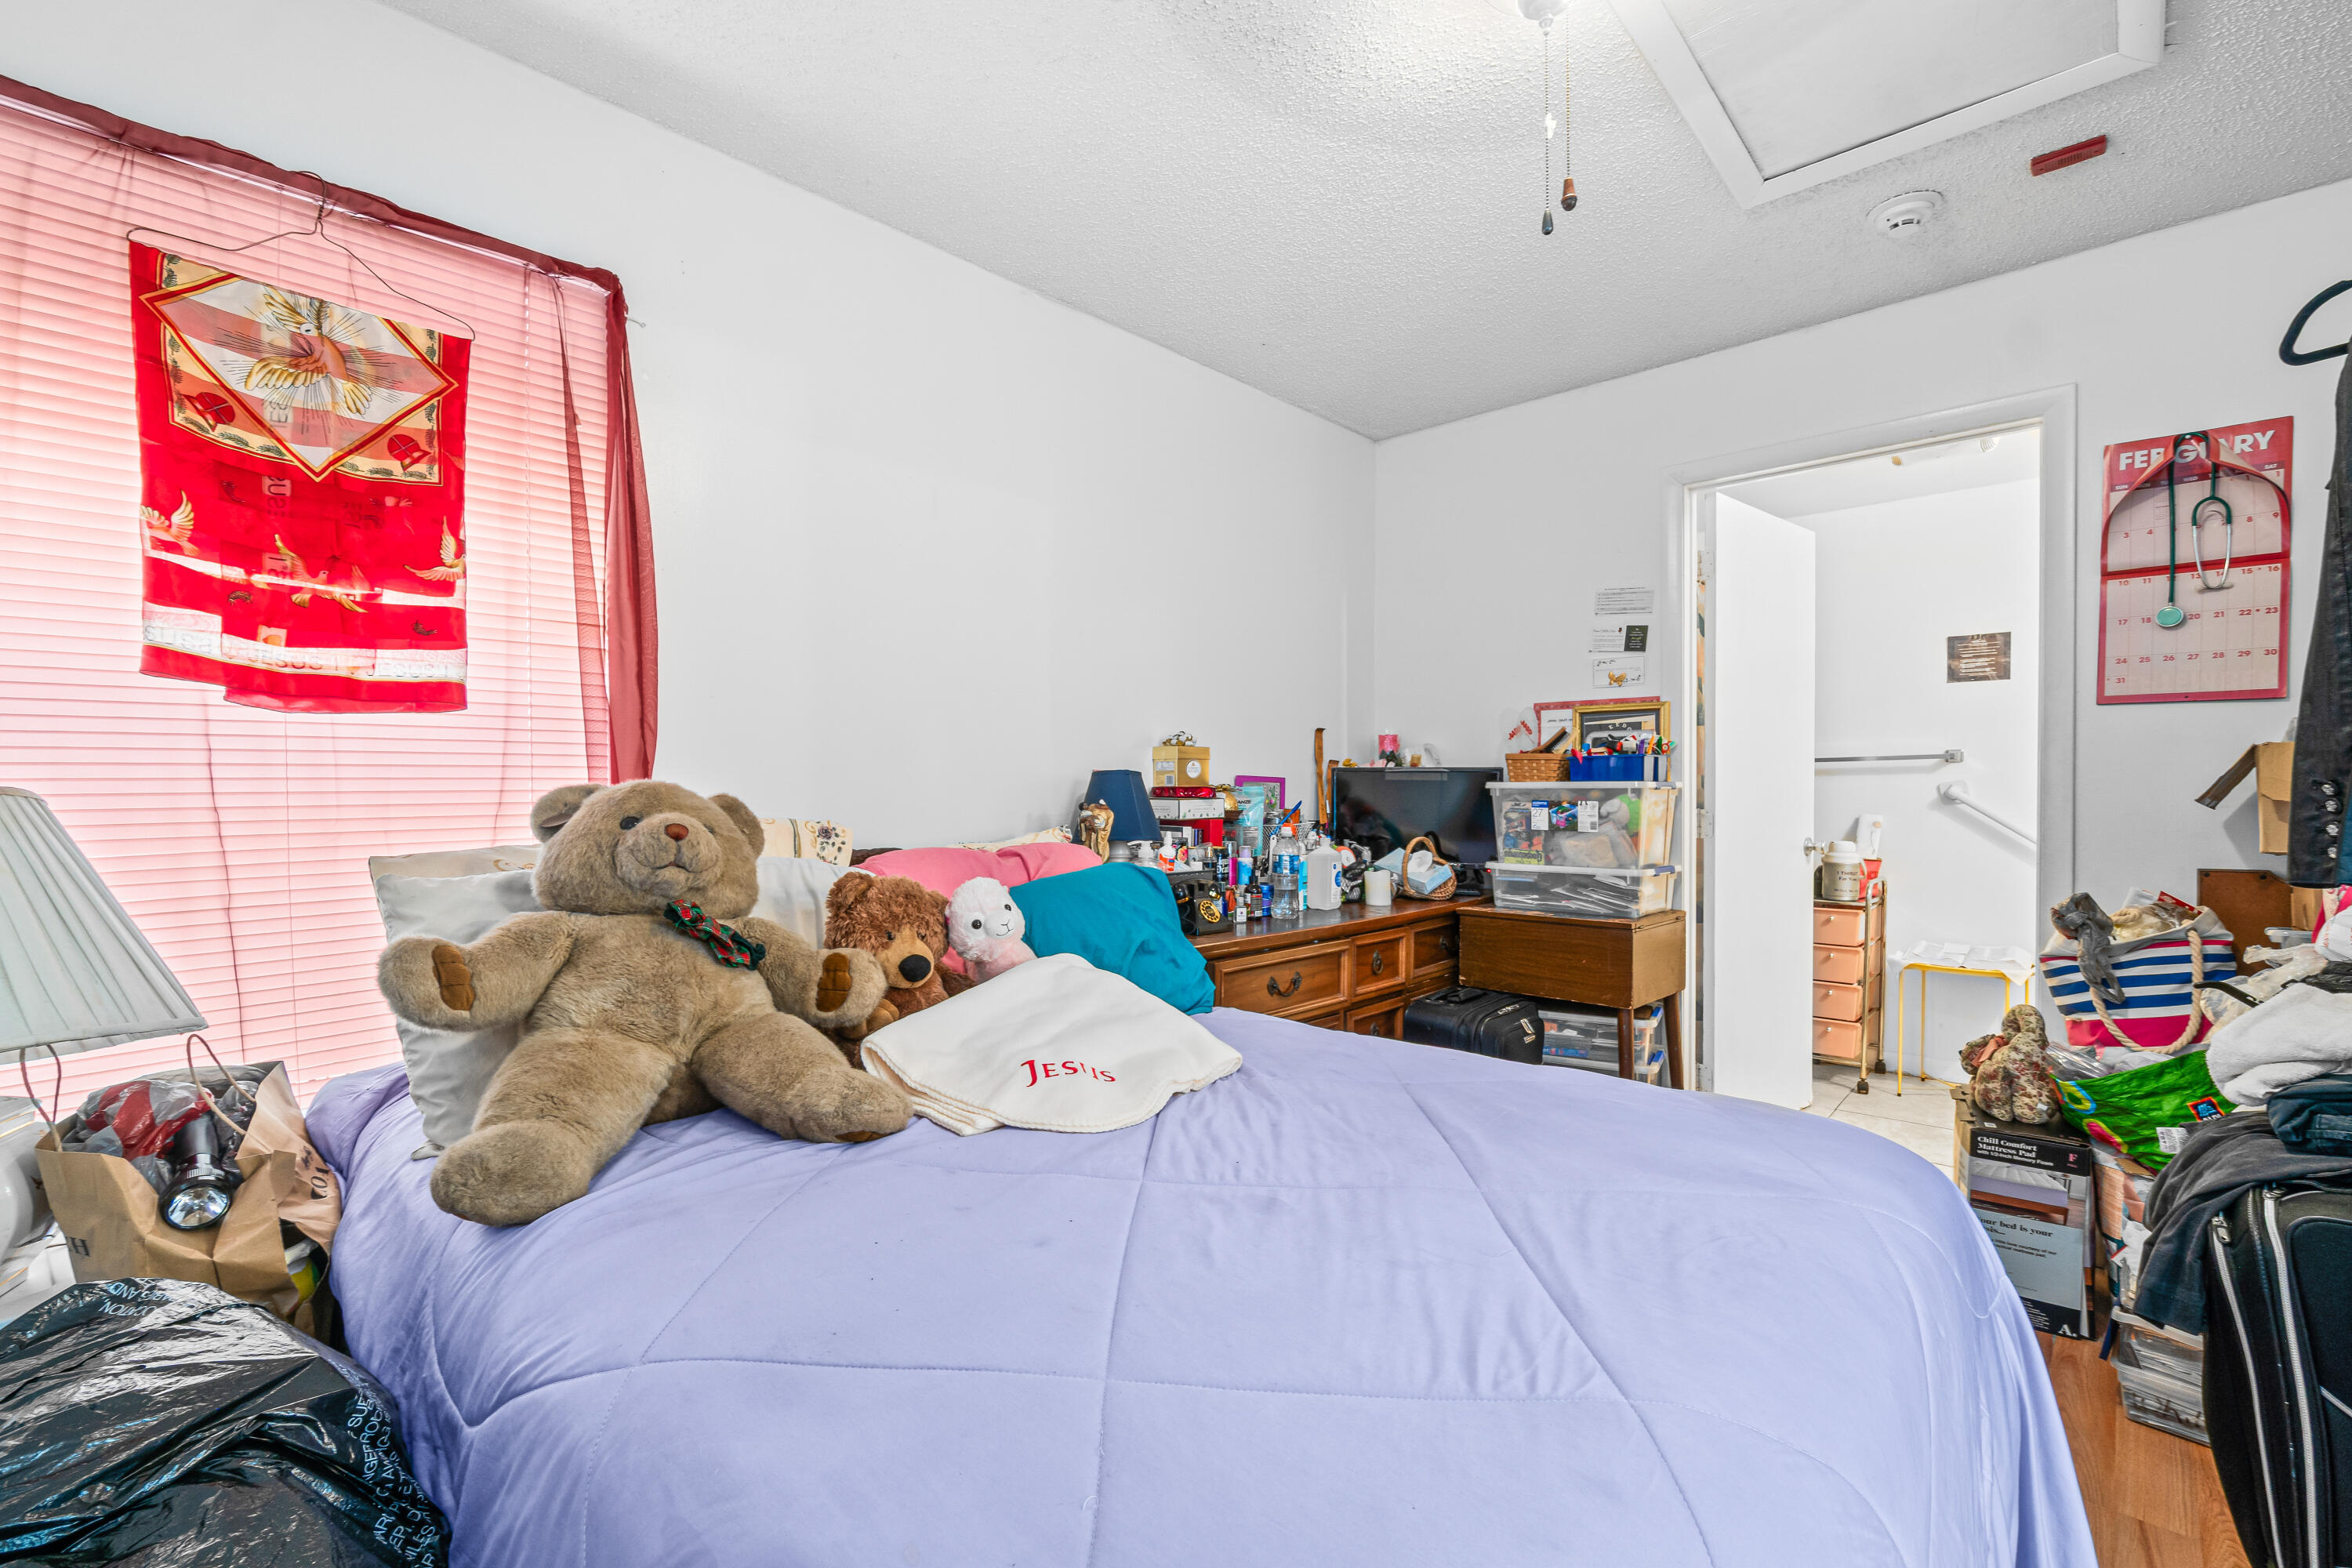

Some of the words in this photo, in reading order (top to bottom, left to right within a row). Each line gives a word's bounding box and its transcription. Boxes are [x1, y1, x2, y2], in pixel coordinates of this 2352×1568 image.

[1977, 1143, 2017, 1154] Mattress
[2000, 1140, 2037, 1151] Comfort
[2013, 1156, 2036, 1164] Memory
[1999, 1221, 2016, 1229] bed
[2030, 1229, 2053, 1237] your
